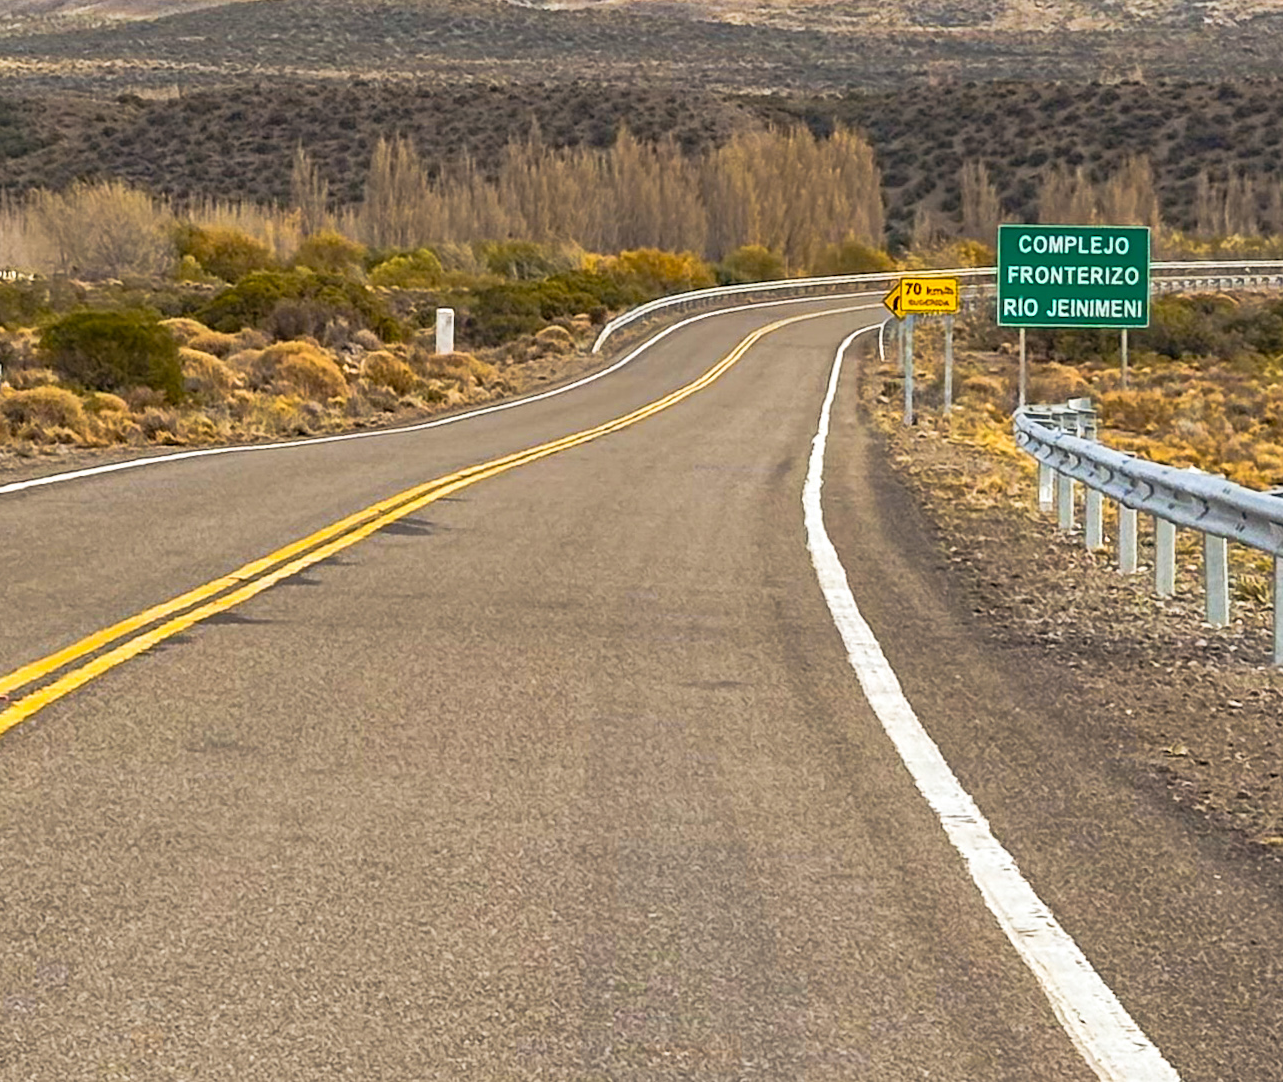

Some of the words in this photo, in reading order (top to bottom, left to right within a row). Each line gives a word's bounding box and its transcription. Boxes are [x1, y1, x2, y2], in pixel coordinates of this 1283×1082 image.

[1019, 235, 1129, 255] COMPLEJO
[1008, 265, 1140, 286] FRONTERIZO
[905, 282, 922, 295] 70
[1046, 299, 1143, 318] JEINIMENI
